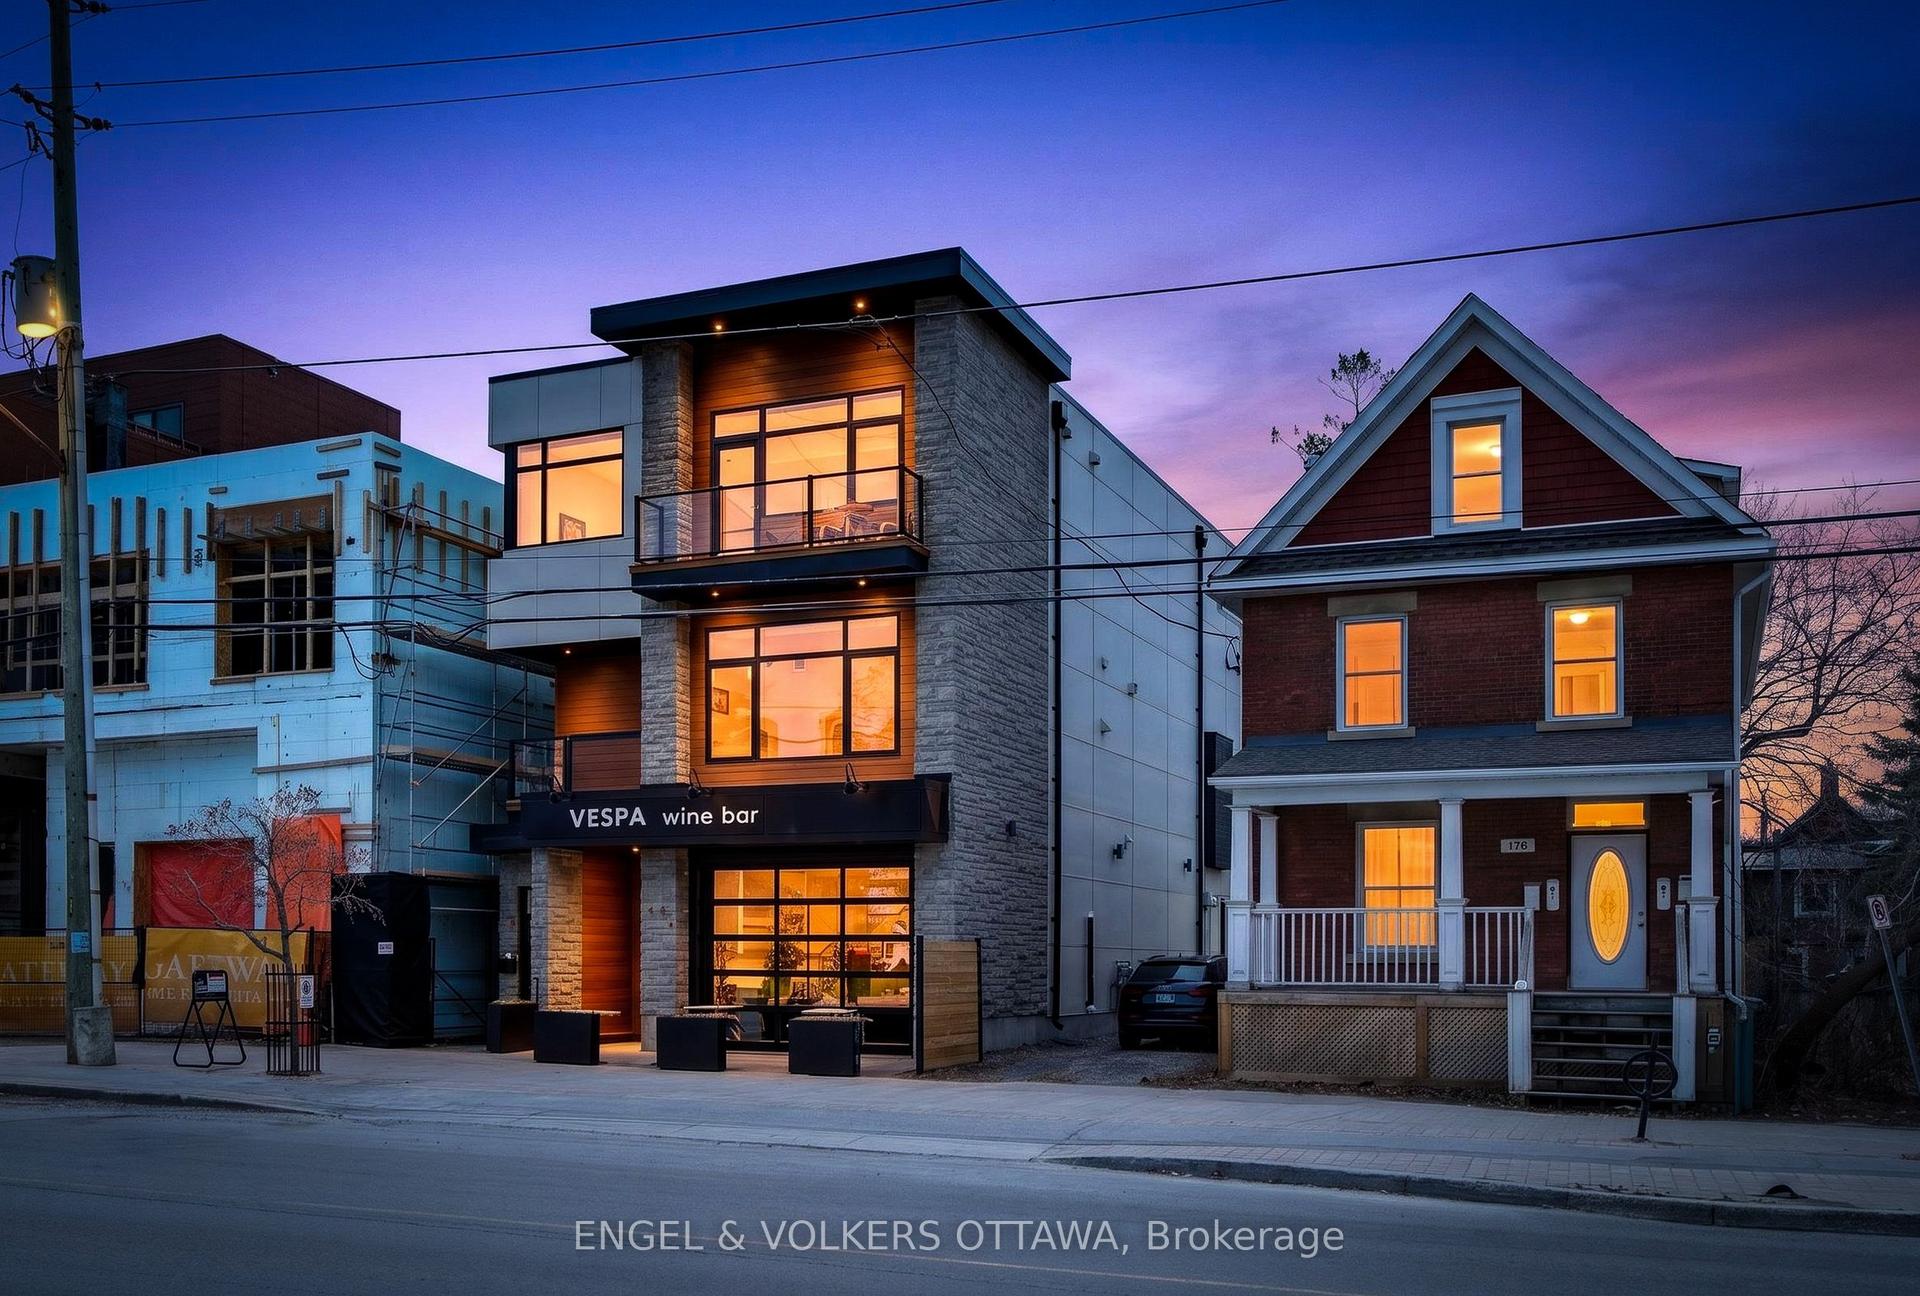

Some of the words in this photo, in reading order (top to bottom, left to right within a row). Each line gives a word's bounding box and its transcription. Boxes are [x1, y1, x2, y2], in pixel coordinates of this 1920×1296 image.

[569, 806, 646, 828] VESPA
[662, 806, 714, 826] wine
[721, 805, 760, 825] bar
[1508, 840, 1528, 851] 176
